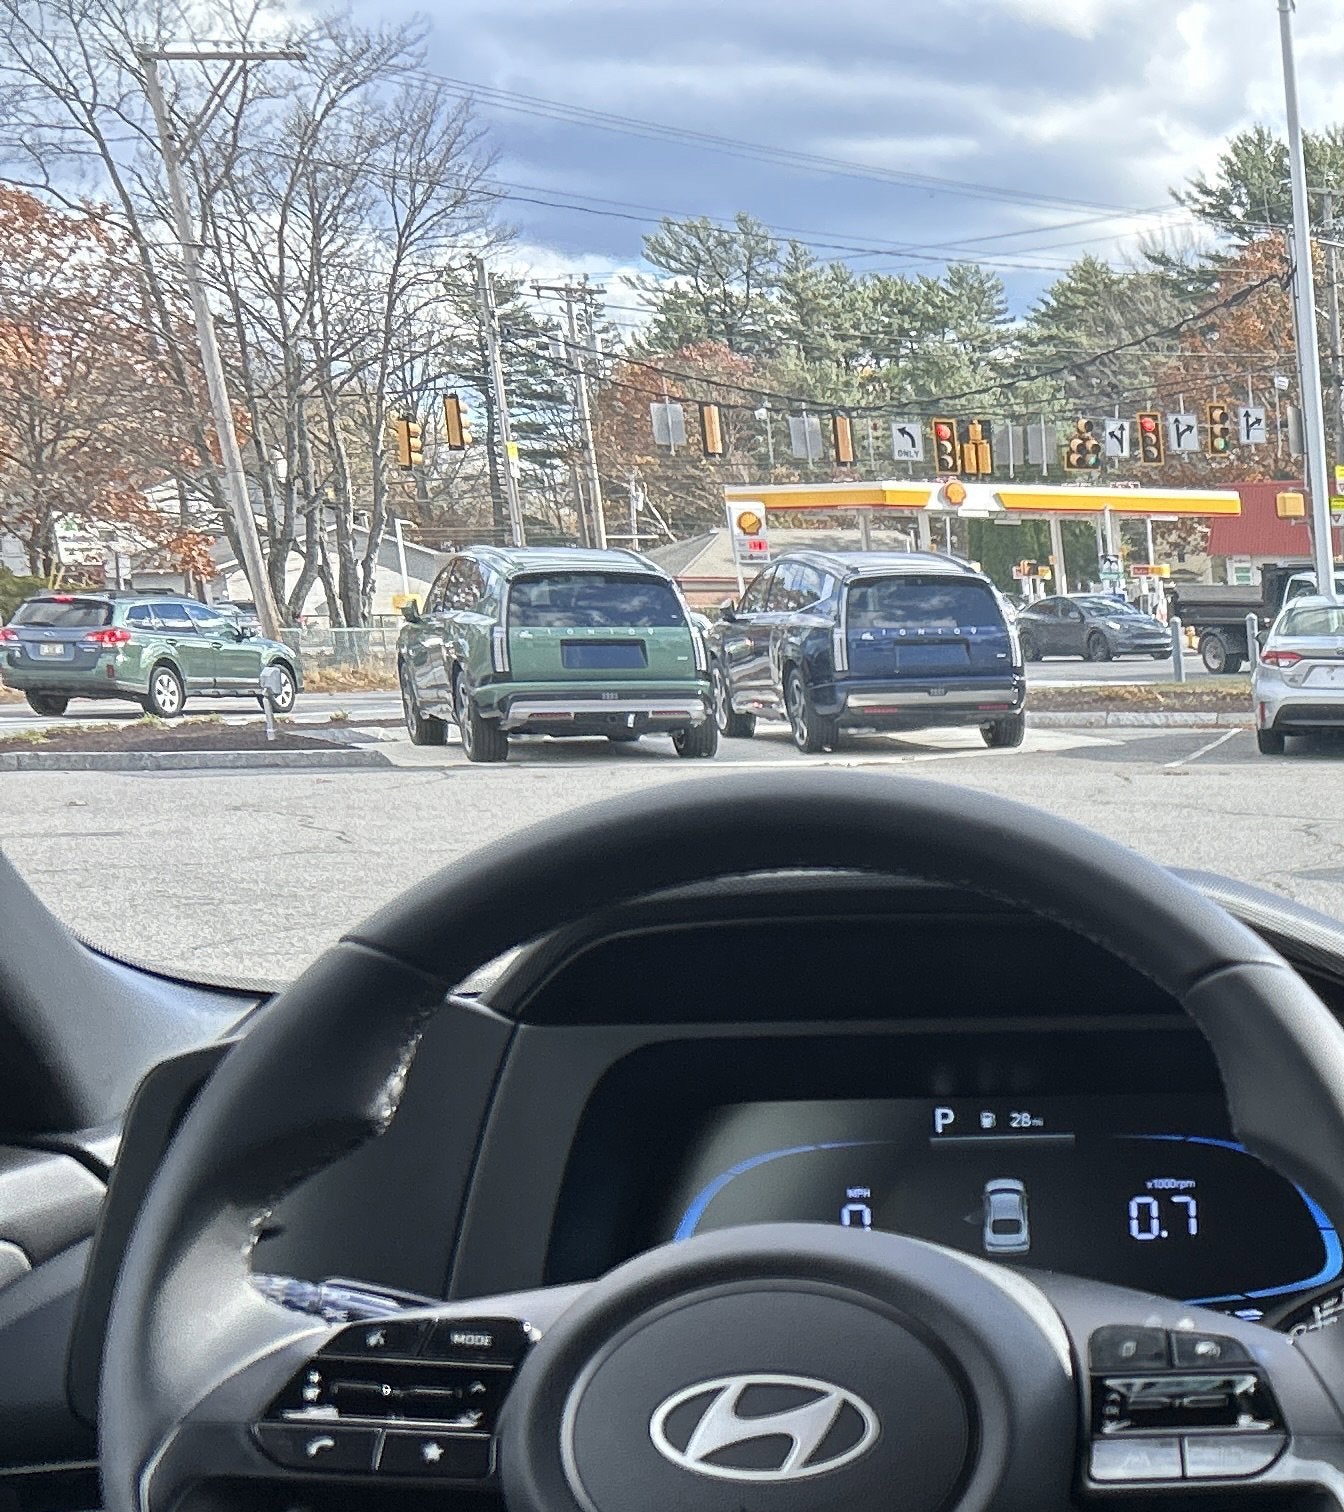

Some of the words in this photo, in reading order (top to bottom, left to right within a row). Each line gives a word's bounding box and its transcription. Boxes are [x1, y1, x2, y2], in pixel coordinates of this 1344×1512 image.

[897, 449, 920, 458] ONLY
[933, 1106, 955, 1134] P
[845, 1188, 871, 1198] MPH
[1128, 1195, 1198, 1240] 0.7
[451, 1333, 494, 1348] MODE
